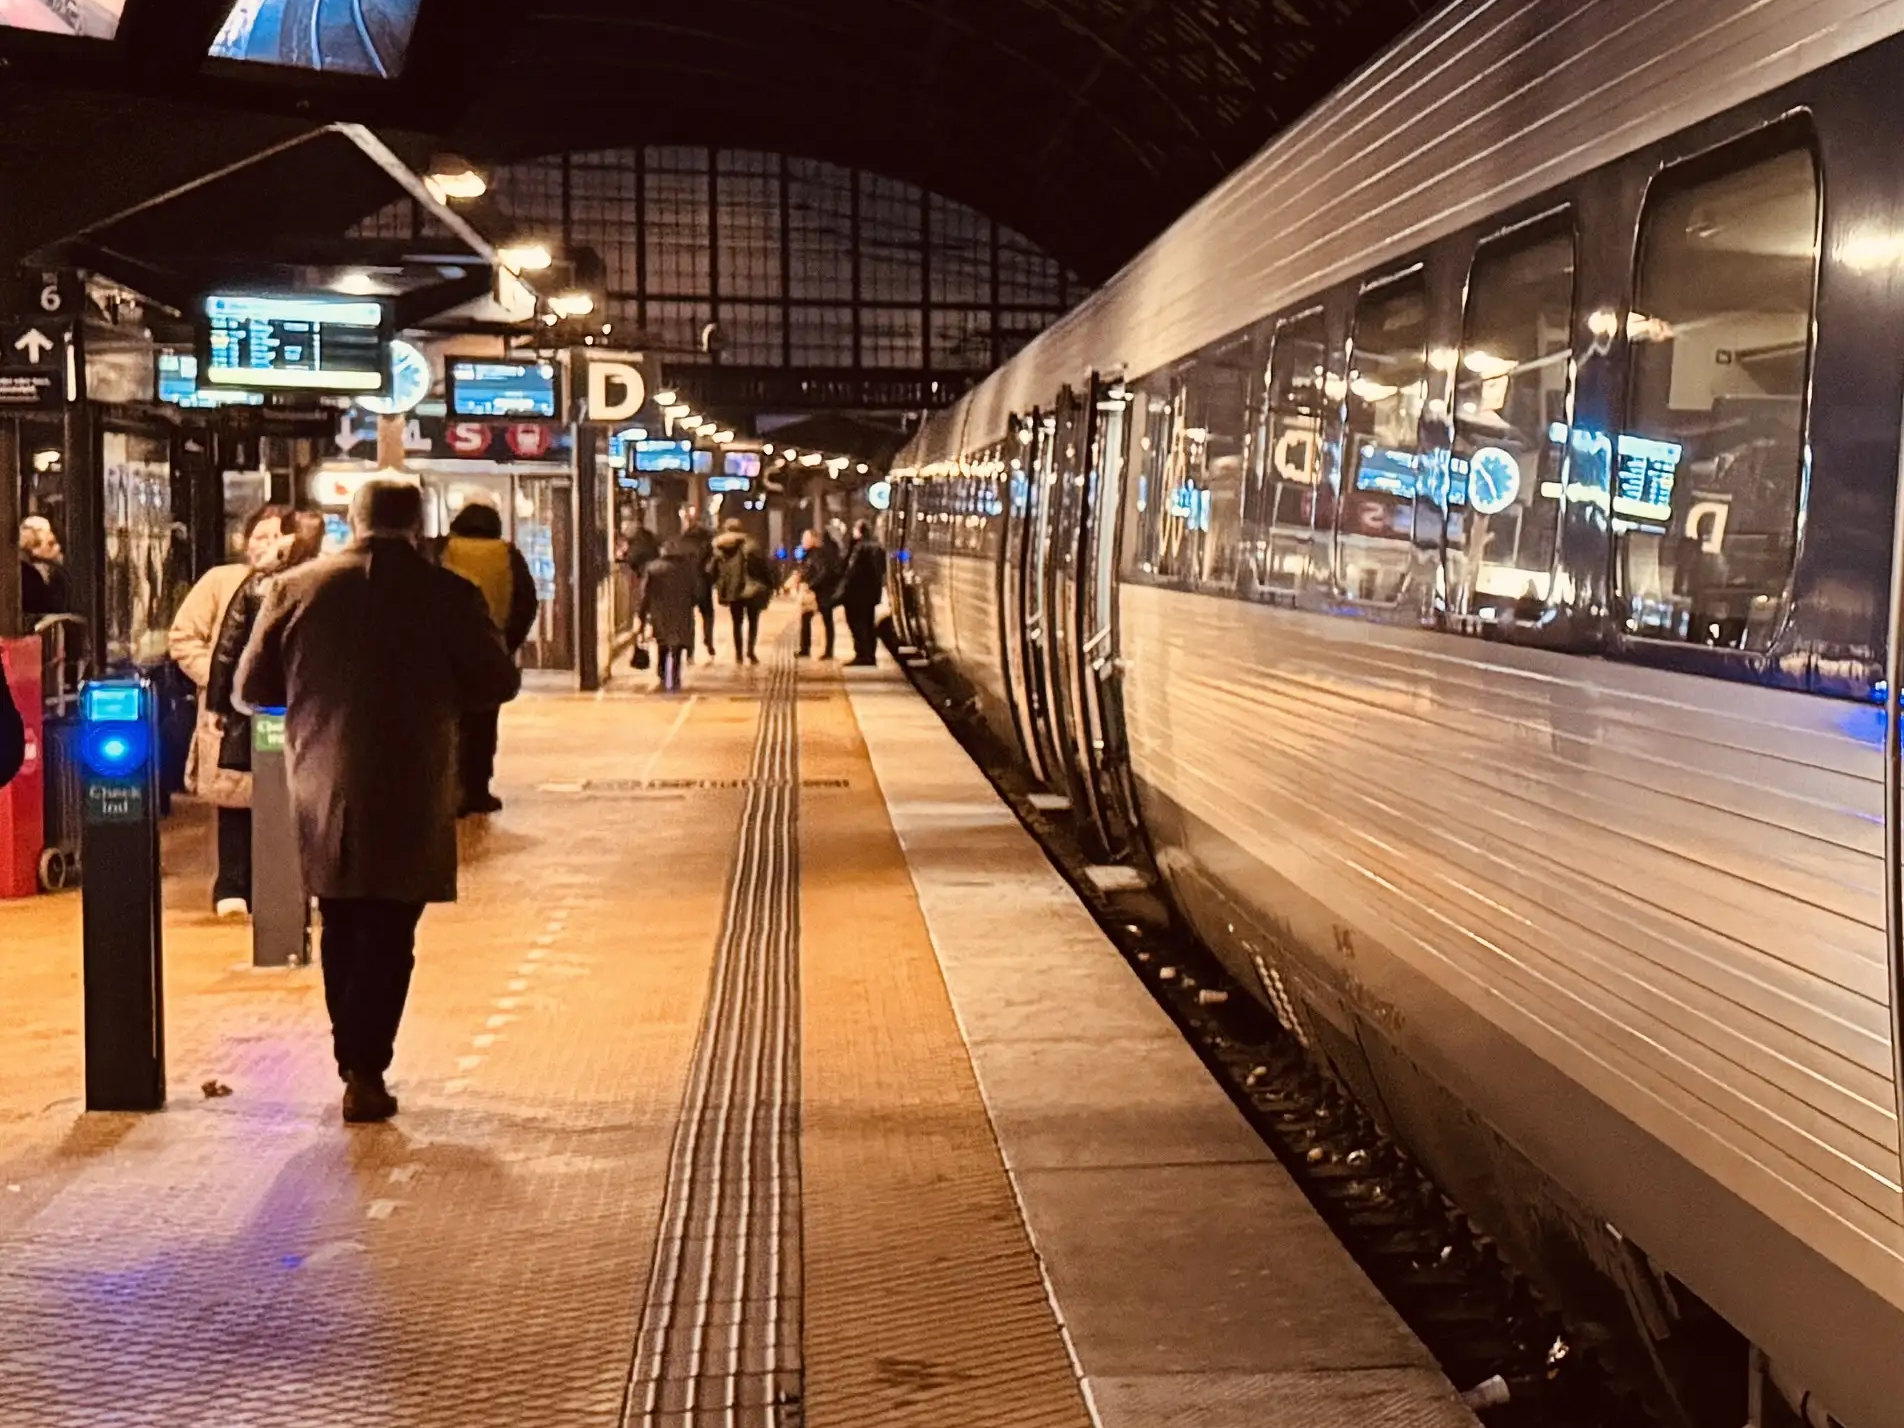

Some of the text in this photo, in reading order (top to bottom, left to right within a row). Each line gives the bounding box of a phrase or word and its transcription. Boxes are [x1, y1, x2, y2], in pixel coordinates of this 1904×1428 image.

[41, 285, 61, 311] 6
[588, 362, 644, 420] D
[455, 423, 483, 449] S
